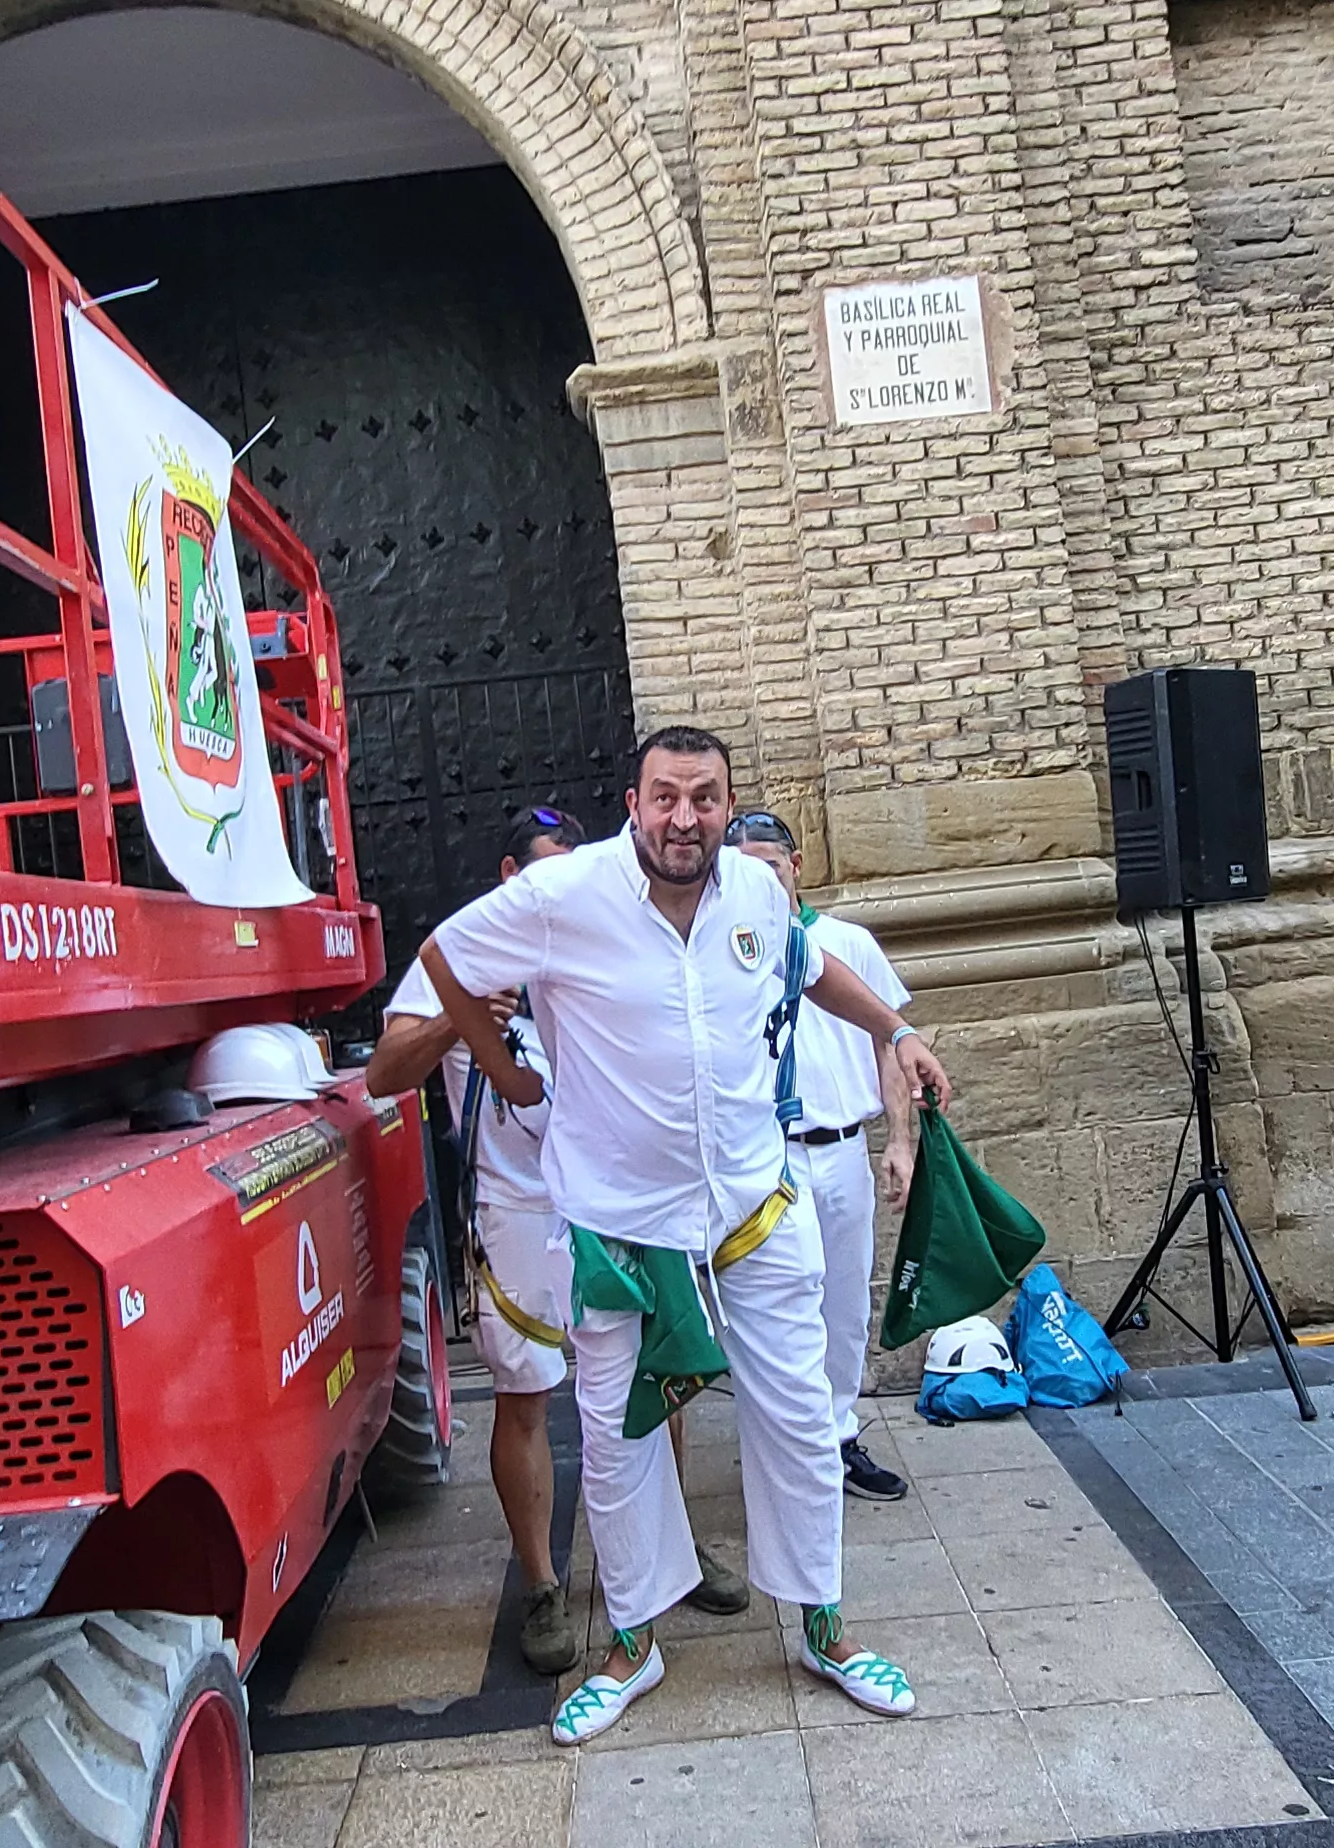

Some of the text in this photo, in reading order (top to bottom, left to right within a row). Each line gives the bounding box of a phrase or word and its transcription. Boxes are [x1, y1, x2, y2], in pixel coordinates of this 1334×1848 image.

[840, 291, 966, 324] BASÍLICA REAL
[844, 319, 969, 352] Y PARROQUIAL
[897, 353, 921, 376] DE
[868, 380, 948, 408] LORENZO
[189, 727, 228, 753] HUESCA
[0, 903, 117, 961] DS1218RT
[281, 1288, 343, 1387] ALQUISER
